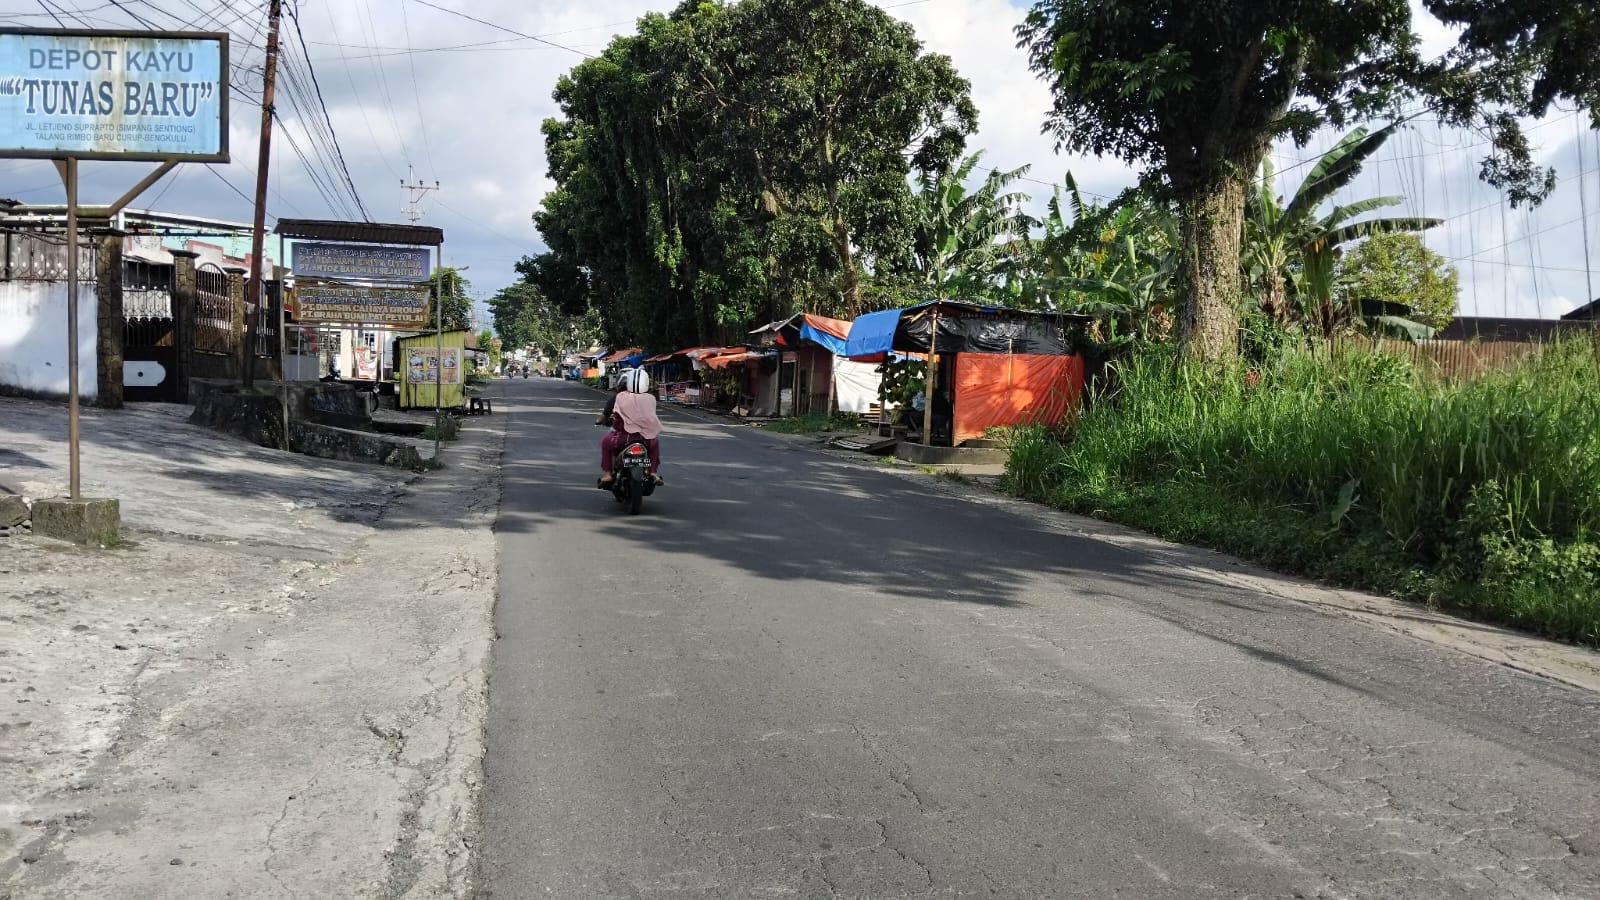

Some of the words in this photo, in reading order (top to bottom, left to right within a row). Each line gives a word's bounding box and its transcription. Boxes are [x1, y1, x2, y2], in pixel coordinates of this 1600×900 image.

[29, 48, 117, 71] DEPOT
[126, 51, 194, 73] KAYU
[38, 123, 73, 131] LETJEND
[74, 123, 115, 132] SUPRAPTO
[116, 123, 153, 133] (SIMPANG
[35, 132, 65, 141] TALANG
[66, 133, 92, 141] RIMBO
[93, 133, 114, 142] BARU
